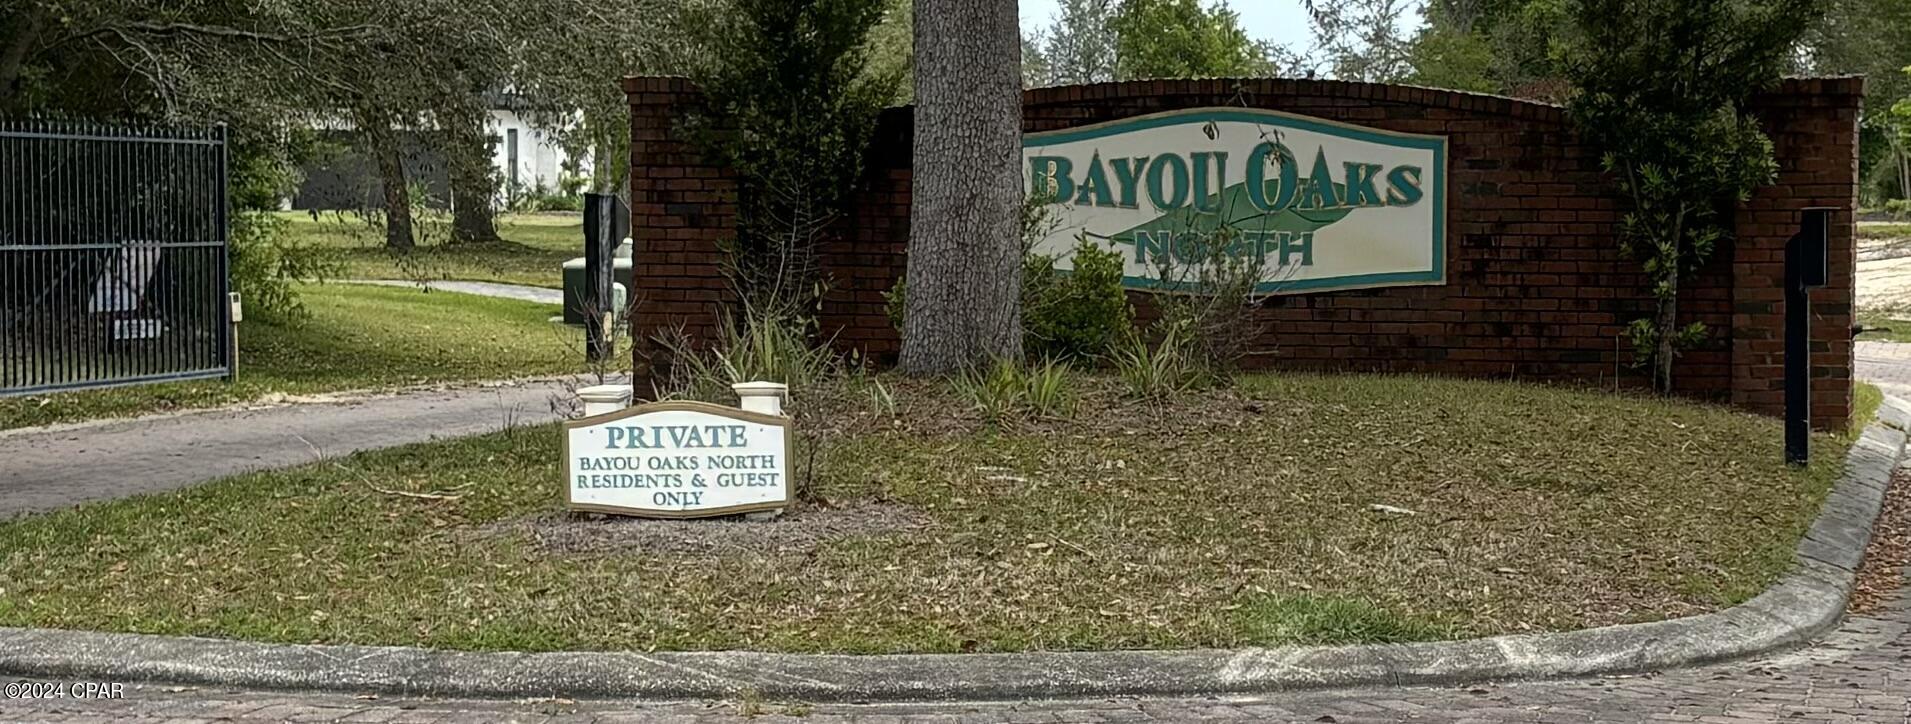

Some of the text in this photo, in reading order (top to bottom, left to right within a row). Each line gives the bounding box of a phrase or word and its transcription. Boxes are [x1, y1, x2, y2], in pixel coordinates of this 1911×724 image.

[1029, 142, 1424, 214] BAYOU OAKS
[605, 425, 747, 449] PRIVATE
[579, 454, 776, 471] BAYOU OAKS NORTH
[577, 472, 780, 489] RESIDENTS & GUEST
[653, 491, 703, 507] ONLY
